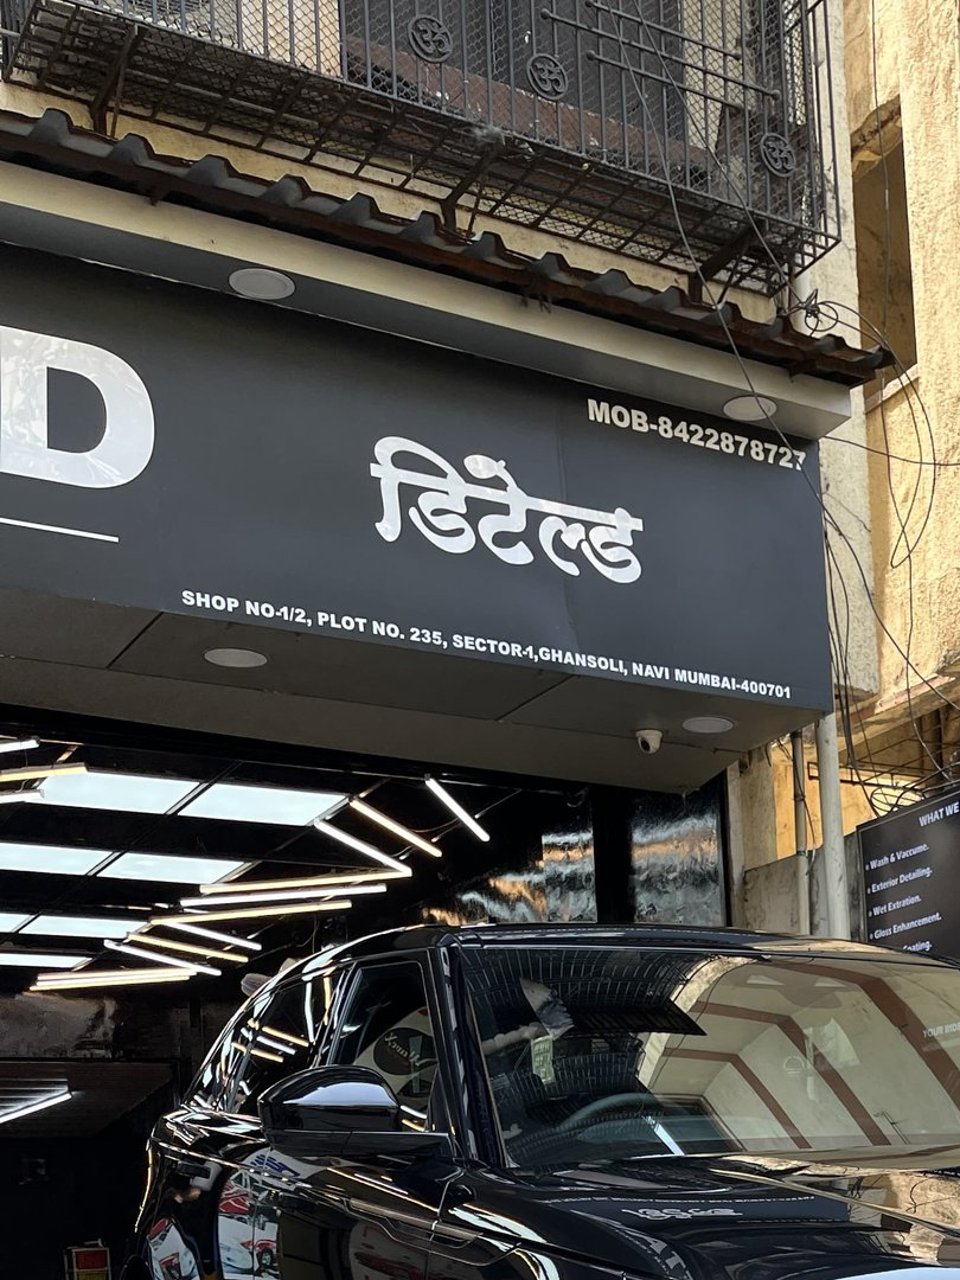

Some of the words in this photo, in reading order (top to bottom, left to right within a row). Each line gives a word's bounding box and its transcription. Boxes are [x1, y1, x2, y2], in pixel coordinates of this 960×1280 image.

[0, 325, 155, 488] D
[587, 398, 806, 471] MOB-8422878727
[181, 590, 239, 613] SHOP
[245, 600, 312, 627] NO-1/2,
[317, 611, 367, 633] PLOT
[372, 620, 405, 640] NO.
[409, 627, 448, 649] 235,
[632, 662, 670, 680] NAVI
[674, 668, 791, 699] MUMBAI-400701
[919, 807, 944, 827] WHAT
[945, 801, 960, 817] WE
[870, 855, 889, 870] Wash
[890, 852, 896, 863] &
[871, 877, 898, 893] Exterior
[899, 867, 933, 884] Detailing.
[872, 904, 887, 916] Wet
[874, 927, 892, 939] Gloss
[893, 912, 942, 933] Enhancement.
